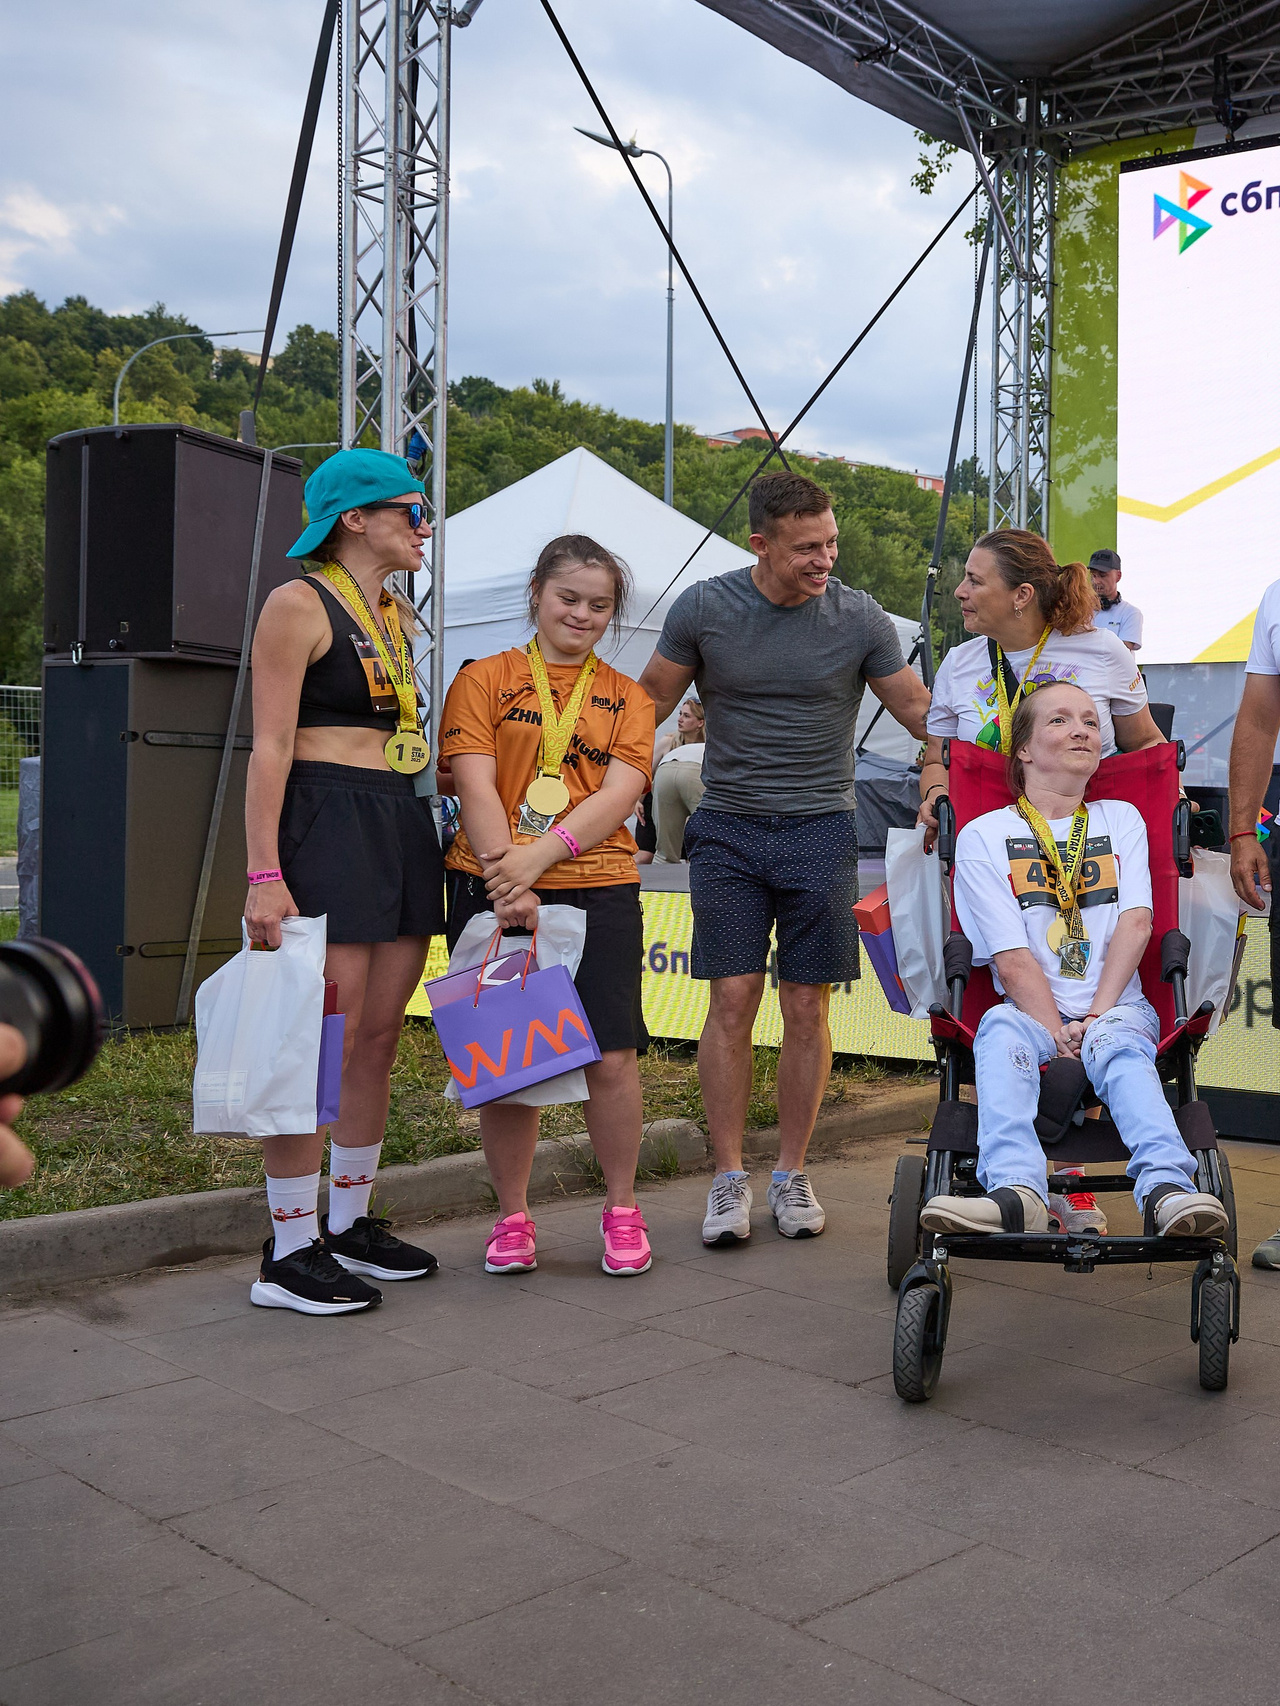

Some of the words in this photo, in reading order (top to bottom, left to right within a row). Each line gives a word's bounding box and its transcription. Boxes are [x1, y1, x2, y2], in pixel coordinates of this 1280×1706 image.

[591, 695, 611, 707] IRON
[444, 727, 461, 739] сбп
[394, 743, 404, 762] 1
[411, 751, 426, 759] STAR
[1068, 815, 1085, 851] IRONSTAR
[1064, 851, 1077, 874] 2025
[1026, 860, 1101, 889] 459
[1058, 884, 1070, 902] 2025
[642, 941, 690, 975] бп
[446, 1008, 590, 1089] WM
